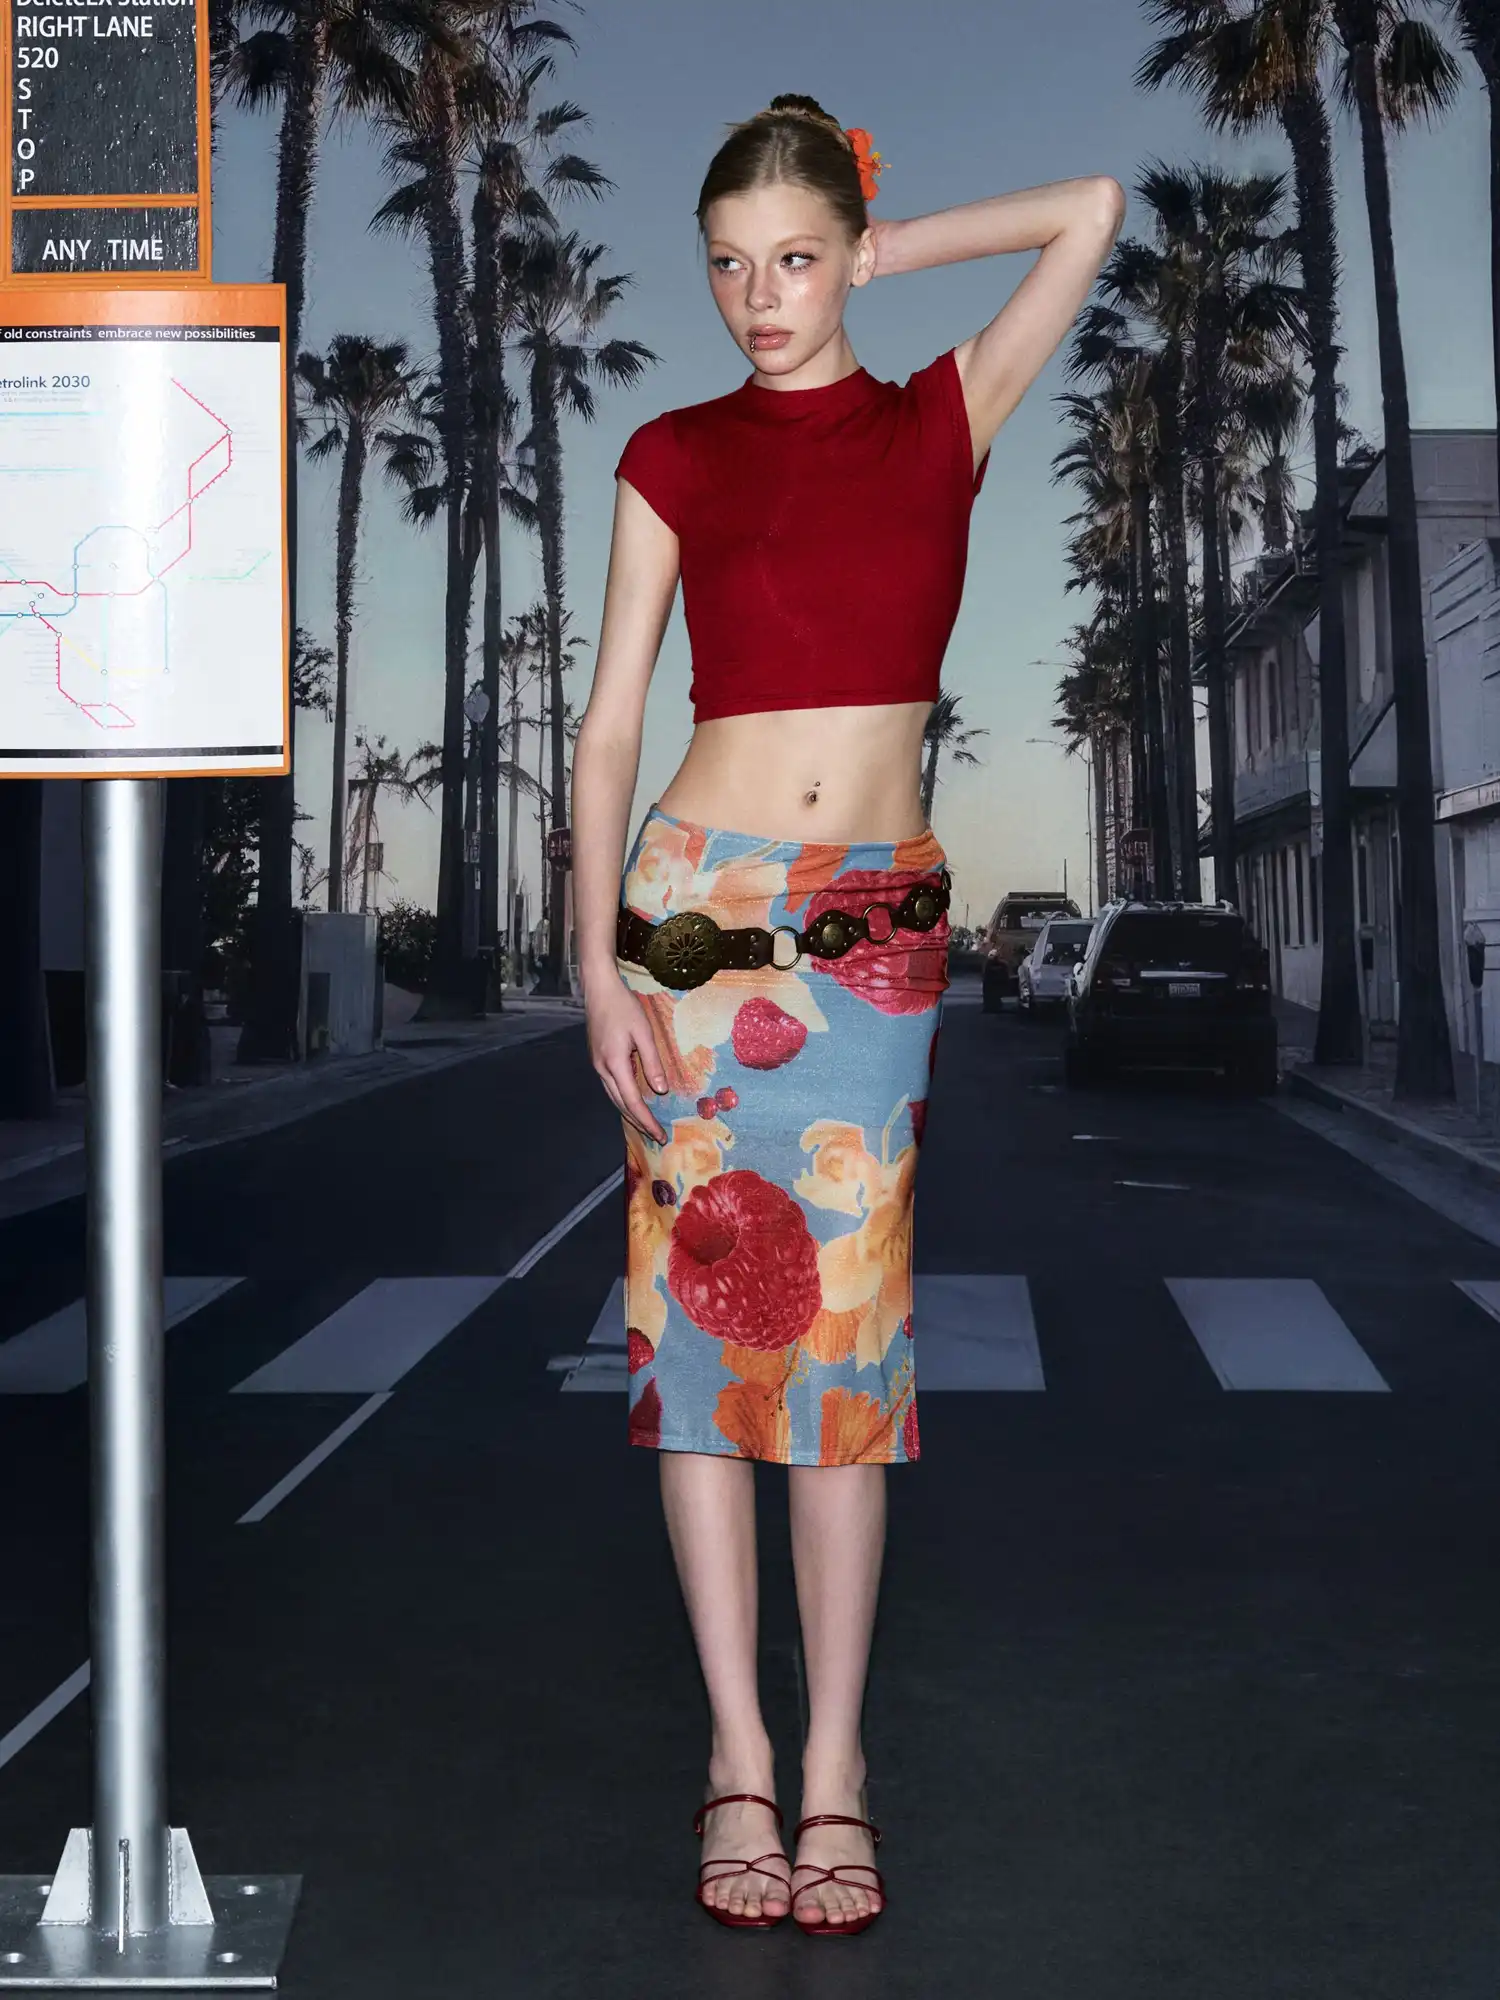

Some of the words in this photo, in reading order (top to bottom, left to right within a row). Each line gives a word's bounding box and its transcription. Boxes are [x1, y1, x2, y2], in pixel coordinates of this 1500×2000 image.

[17, 15, 88, 38] RIGHT
[93, 15, 154, 38] LANE
[17, 46, 59, 69] 520
[42, 239, 92, 261] ANY
[107, 239, 164, 261] TIME
[4, 328, 23, 339] old
[25, 328, 93, 339] constraints
[98, 327, 153, 339] embrace
[155, 329, 182, 339] new
[184, 327, 256, 341] possibilities
[51, 375, 91, 388] 2030
